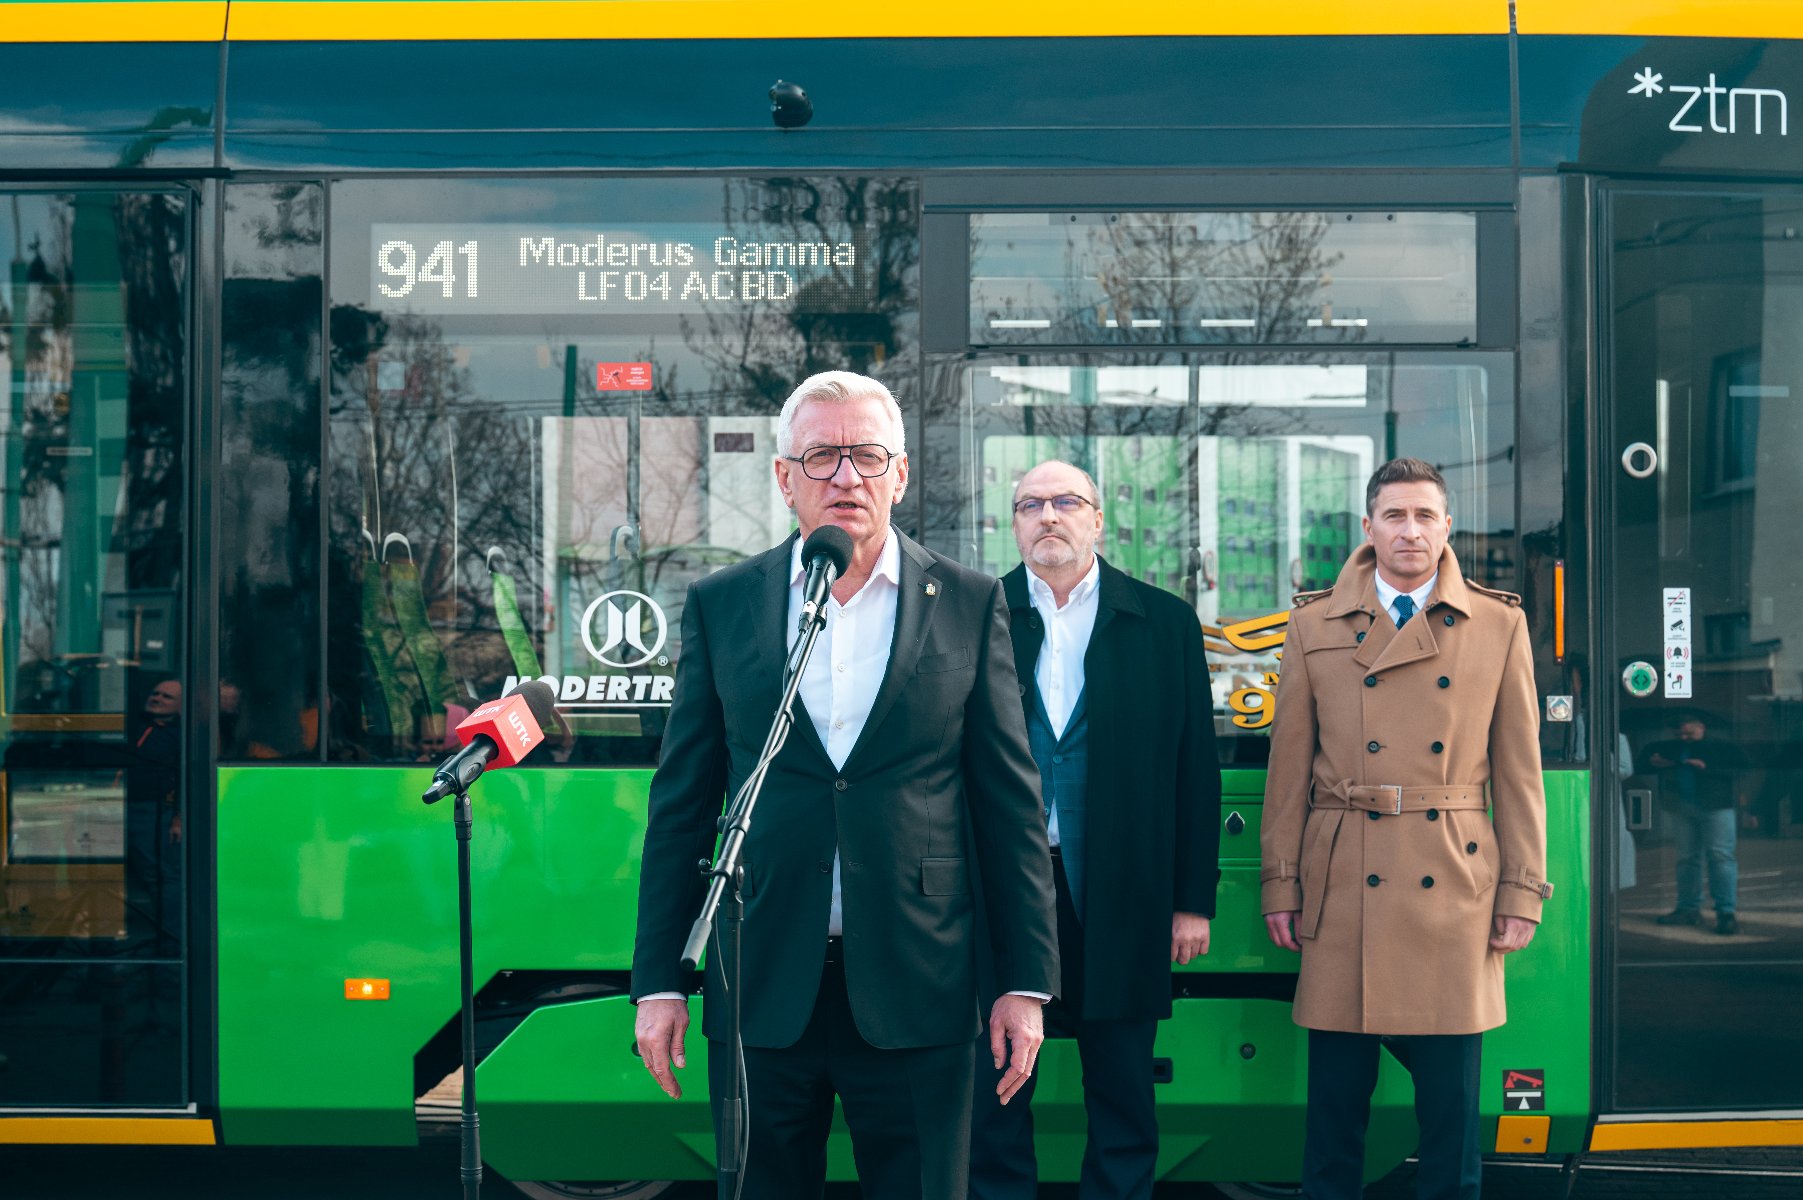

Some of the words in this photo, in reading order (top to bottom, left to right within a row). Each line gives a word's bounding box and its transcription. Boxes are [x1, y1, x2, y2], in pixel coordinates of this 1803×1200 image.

[519, 234, 694, 267] Moderus
[714, 236, 855, 266] Gamma
[378, 240, 478, 298] 941
[578, 271, 672, 301] LF04
[508, 711, 532, 748] WTK
